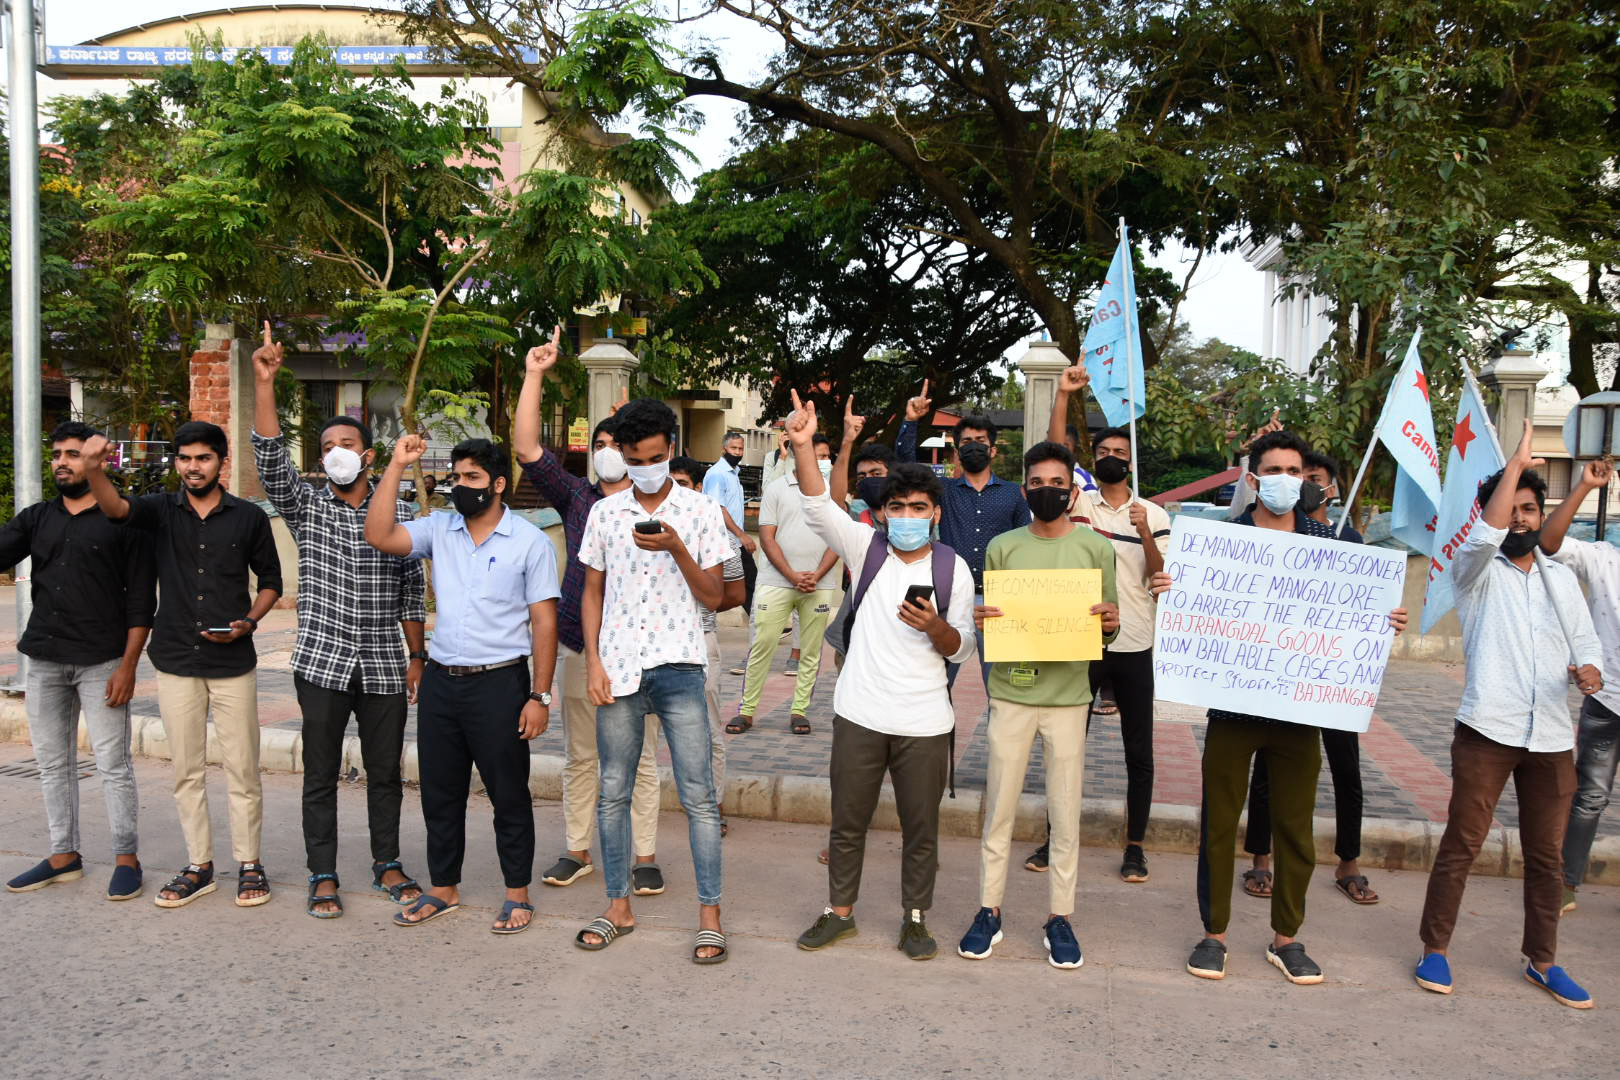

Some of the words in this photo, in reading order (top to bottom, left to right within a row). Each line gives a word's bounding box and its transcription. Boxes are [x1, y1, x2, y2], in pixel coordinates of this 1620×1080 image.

[1181, 532, 1274, 567] DEMANDING
[1283, 545, 1404, 584] COMMISSIONER
[1167, 561, 1196, 584] OF
[1201, 566, 1264, 596] POLICE
[1267, 575, 1384, 610] MANGALORE
[1036, 616, 1095, 635] SILENCE
[1163, 587, 1188, 609] TO
[1190, 594, 1257, 619] ARREST
[1263, 601, 1297, 625] THE
[1304, 607, 1391, 635] RELEASED
[1160, 611, 1271, 644] BAJRANGDAL
[1277, 627, 1343, 658] GOONS
[1352, 637, 1385, 661] ON
[1160, 636, 1193, 655] NON
[1196, 637, 1280, 673] BAILABLE
[1284, 653, 1349, 685] CASES
[1293, 681, 1377, 707] BAJRANGDAL
